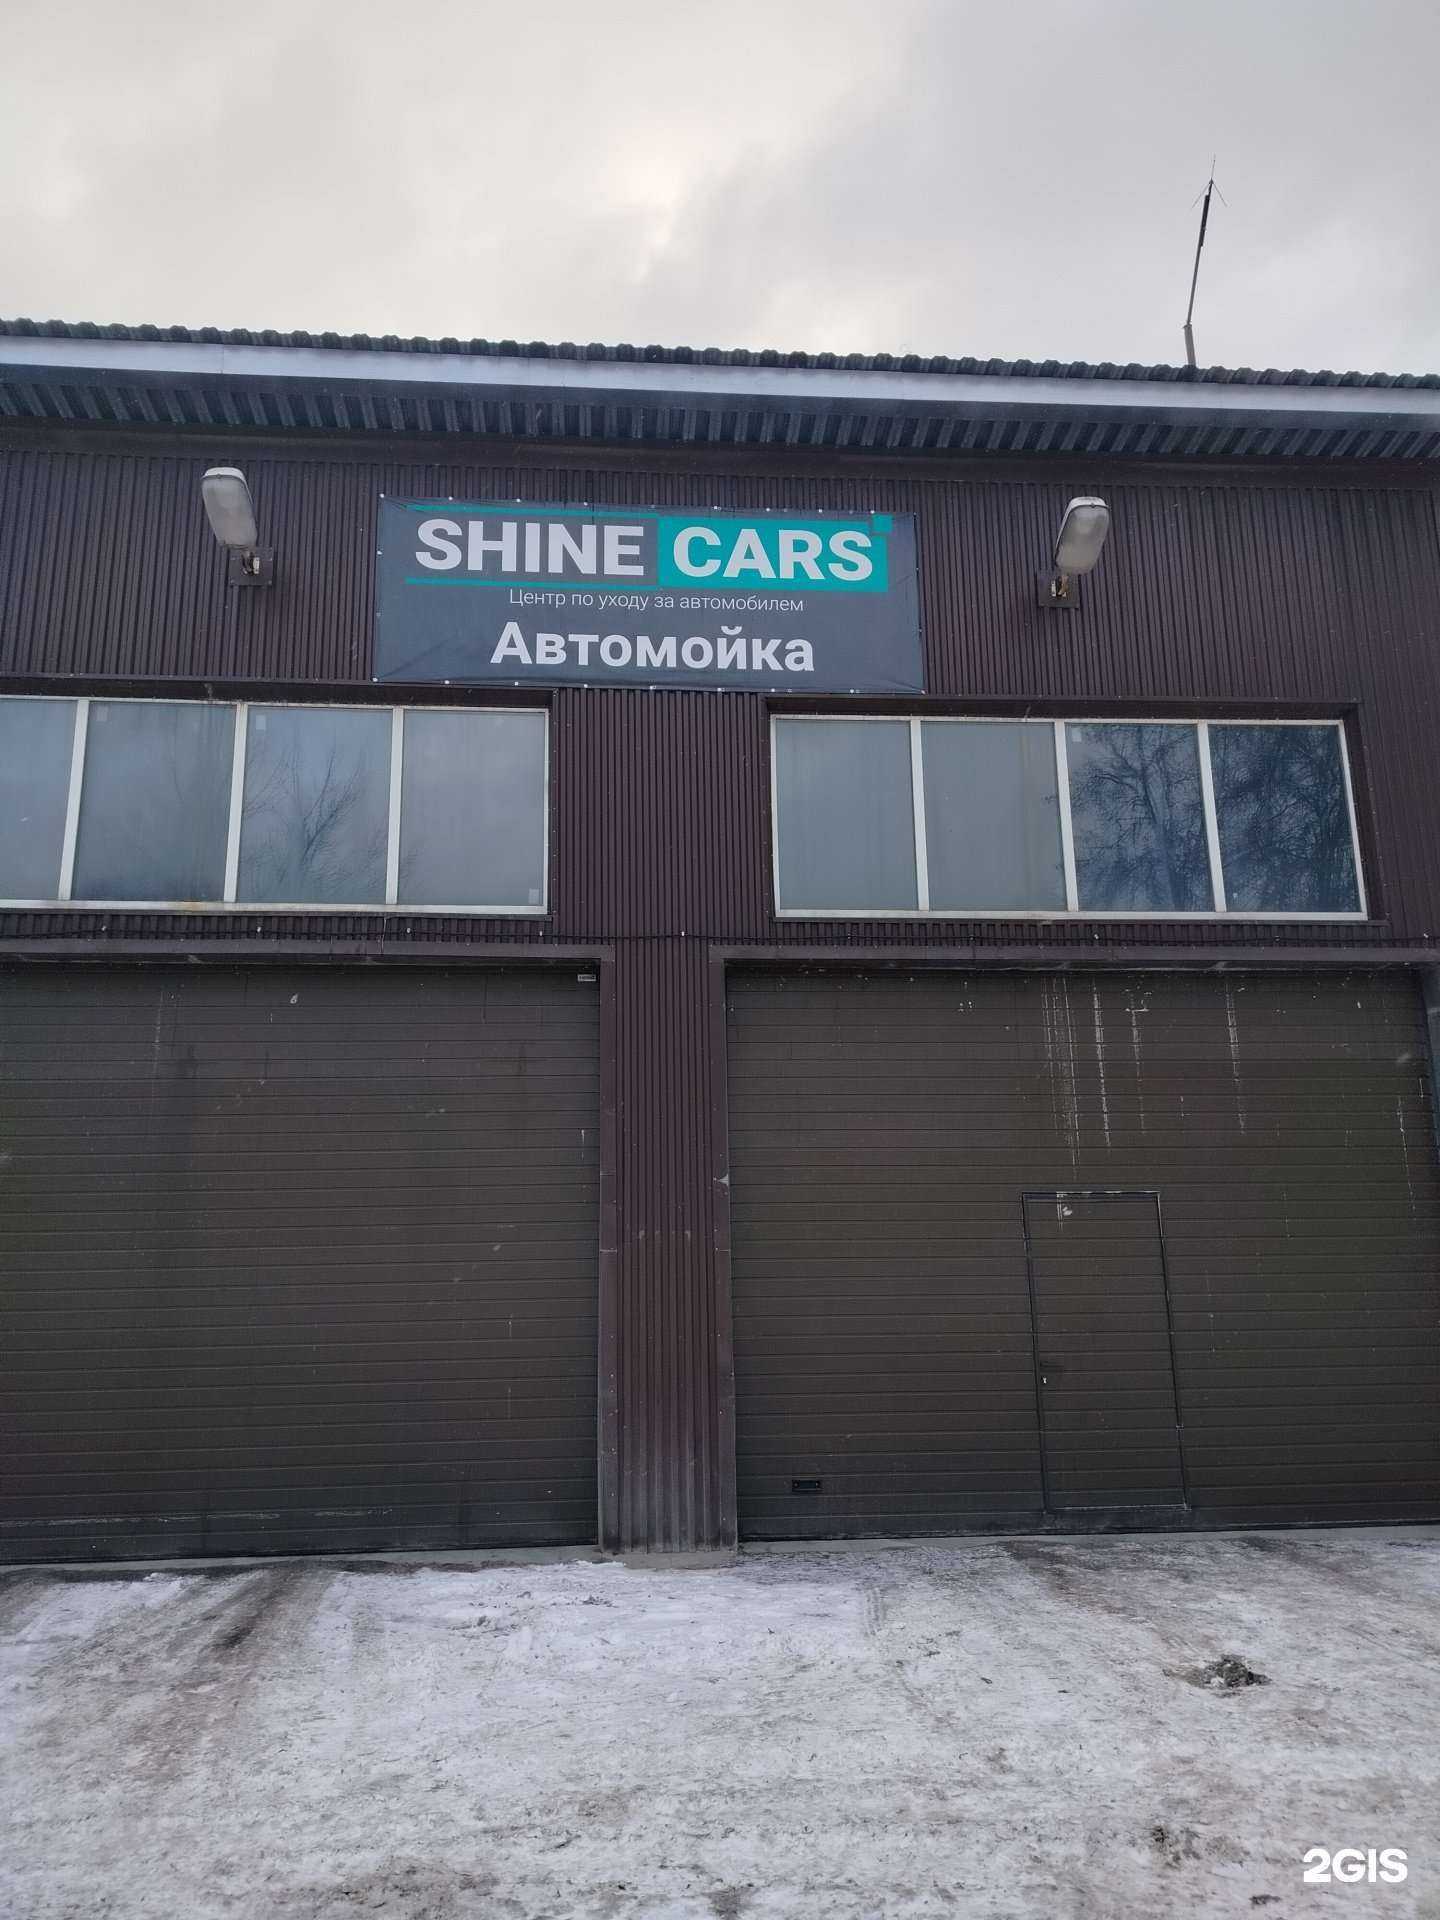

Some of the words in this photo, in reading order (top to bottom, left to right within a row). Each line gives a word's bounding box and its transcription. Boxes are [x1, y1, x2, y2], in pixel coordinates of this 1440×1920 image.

[415, 519, 645, 576] SHINE
[673, 527, 873, 581] CARS
[509, 588, 566, 608] Центр
[571, 593, 594, 606] по
[598, 594, 649, 611] уходу
[654, 595, 675, 608] за
[679, 595, 804, 611] автомобилем
[490, 621, 815, 672] Автомойка
